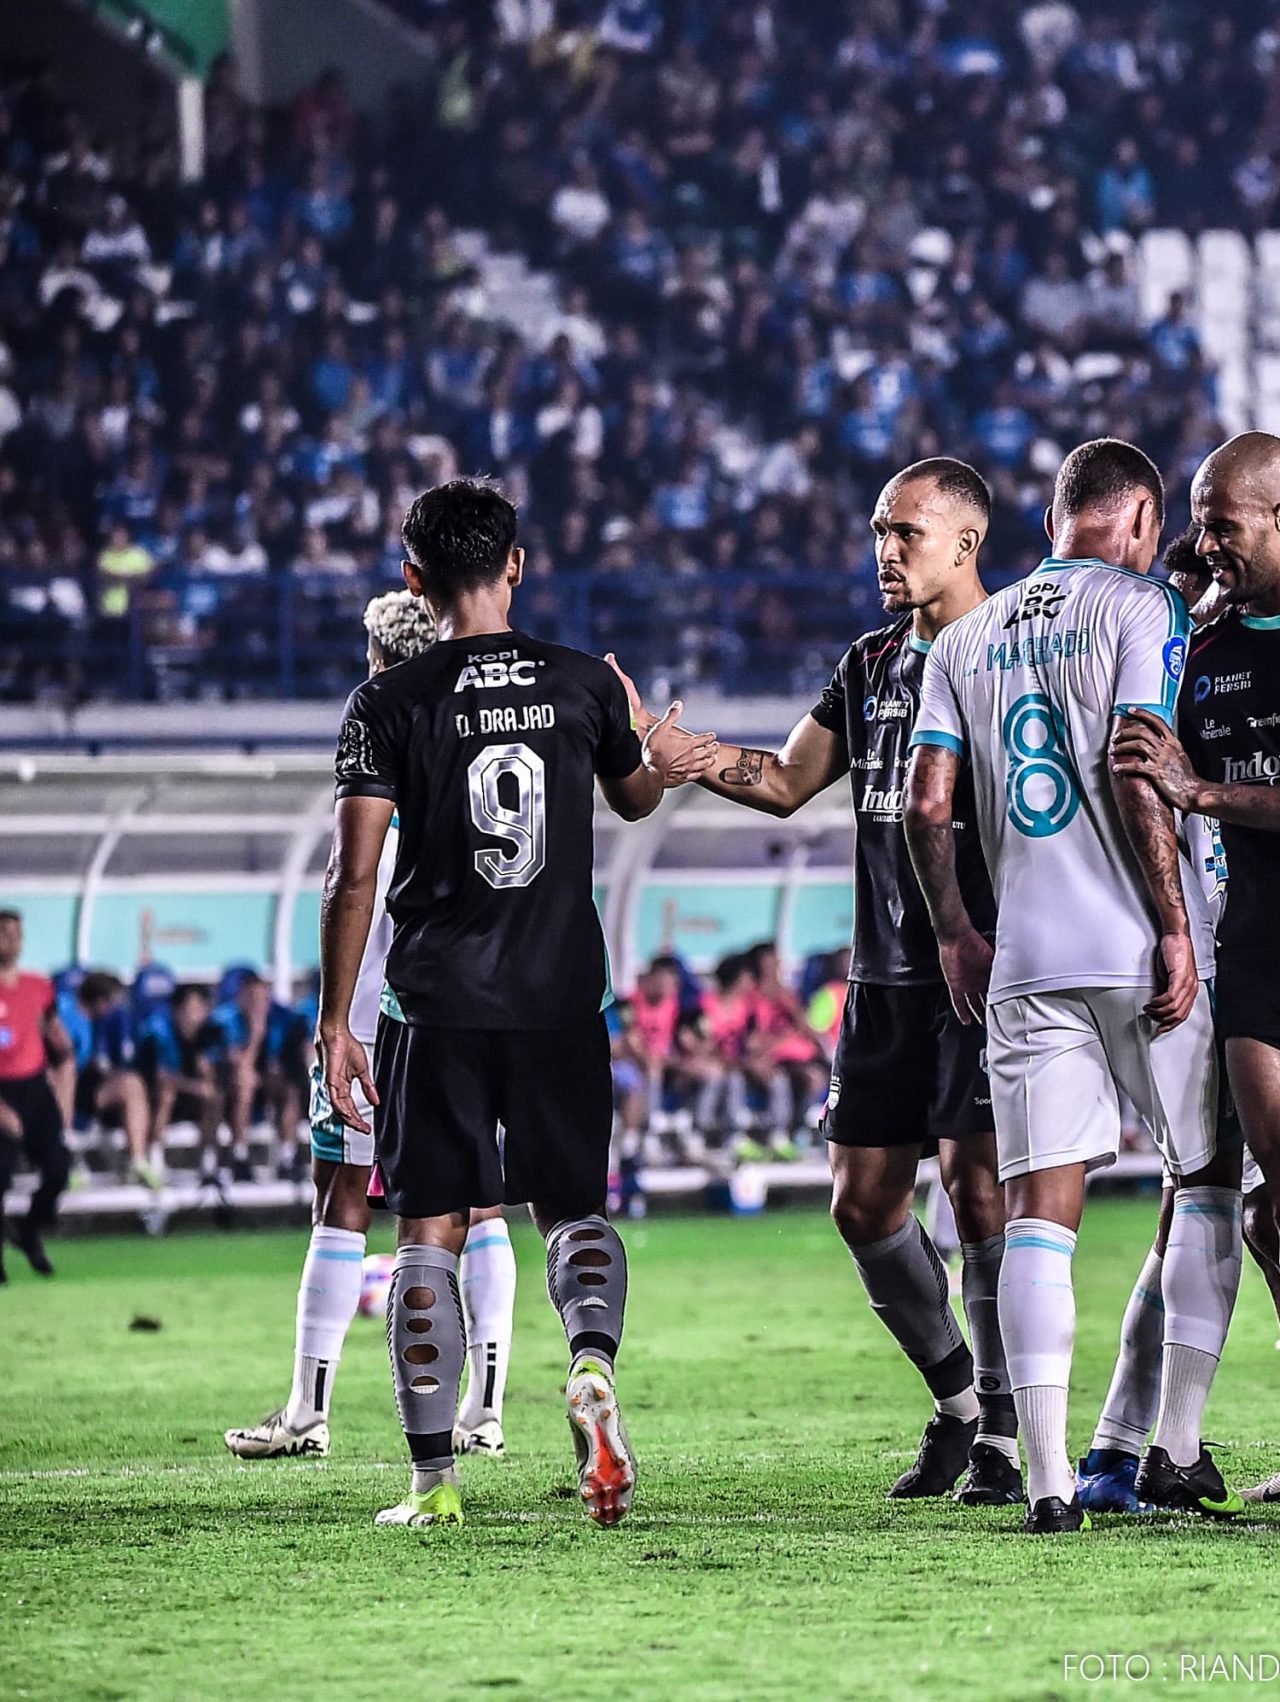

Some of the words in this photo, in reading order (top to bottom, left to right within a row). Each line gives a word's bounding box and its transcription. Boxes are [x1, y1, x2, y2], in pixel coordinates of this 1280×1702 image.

[1028, 583, 1060, 595] OPI
[467, 649, 518, 663] KOPI
[454, 660, 537, 694] ABC
[1214, 671, 1252, 684] PLANET
[480, 704, 555, 735] DRAJAD
[1205, 718, 1215, 730] Le
[1003, 693, 1081, 838] 8
[467, 742, 546, 889] 9
